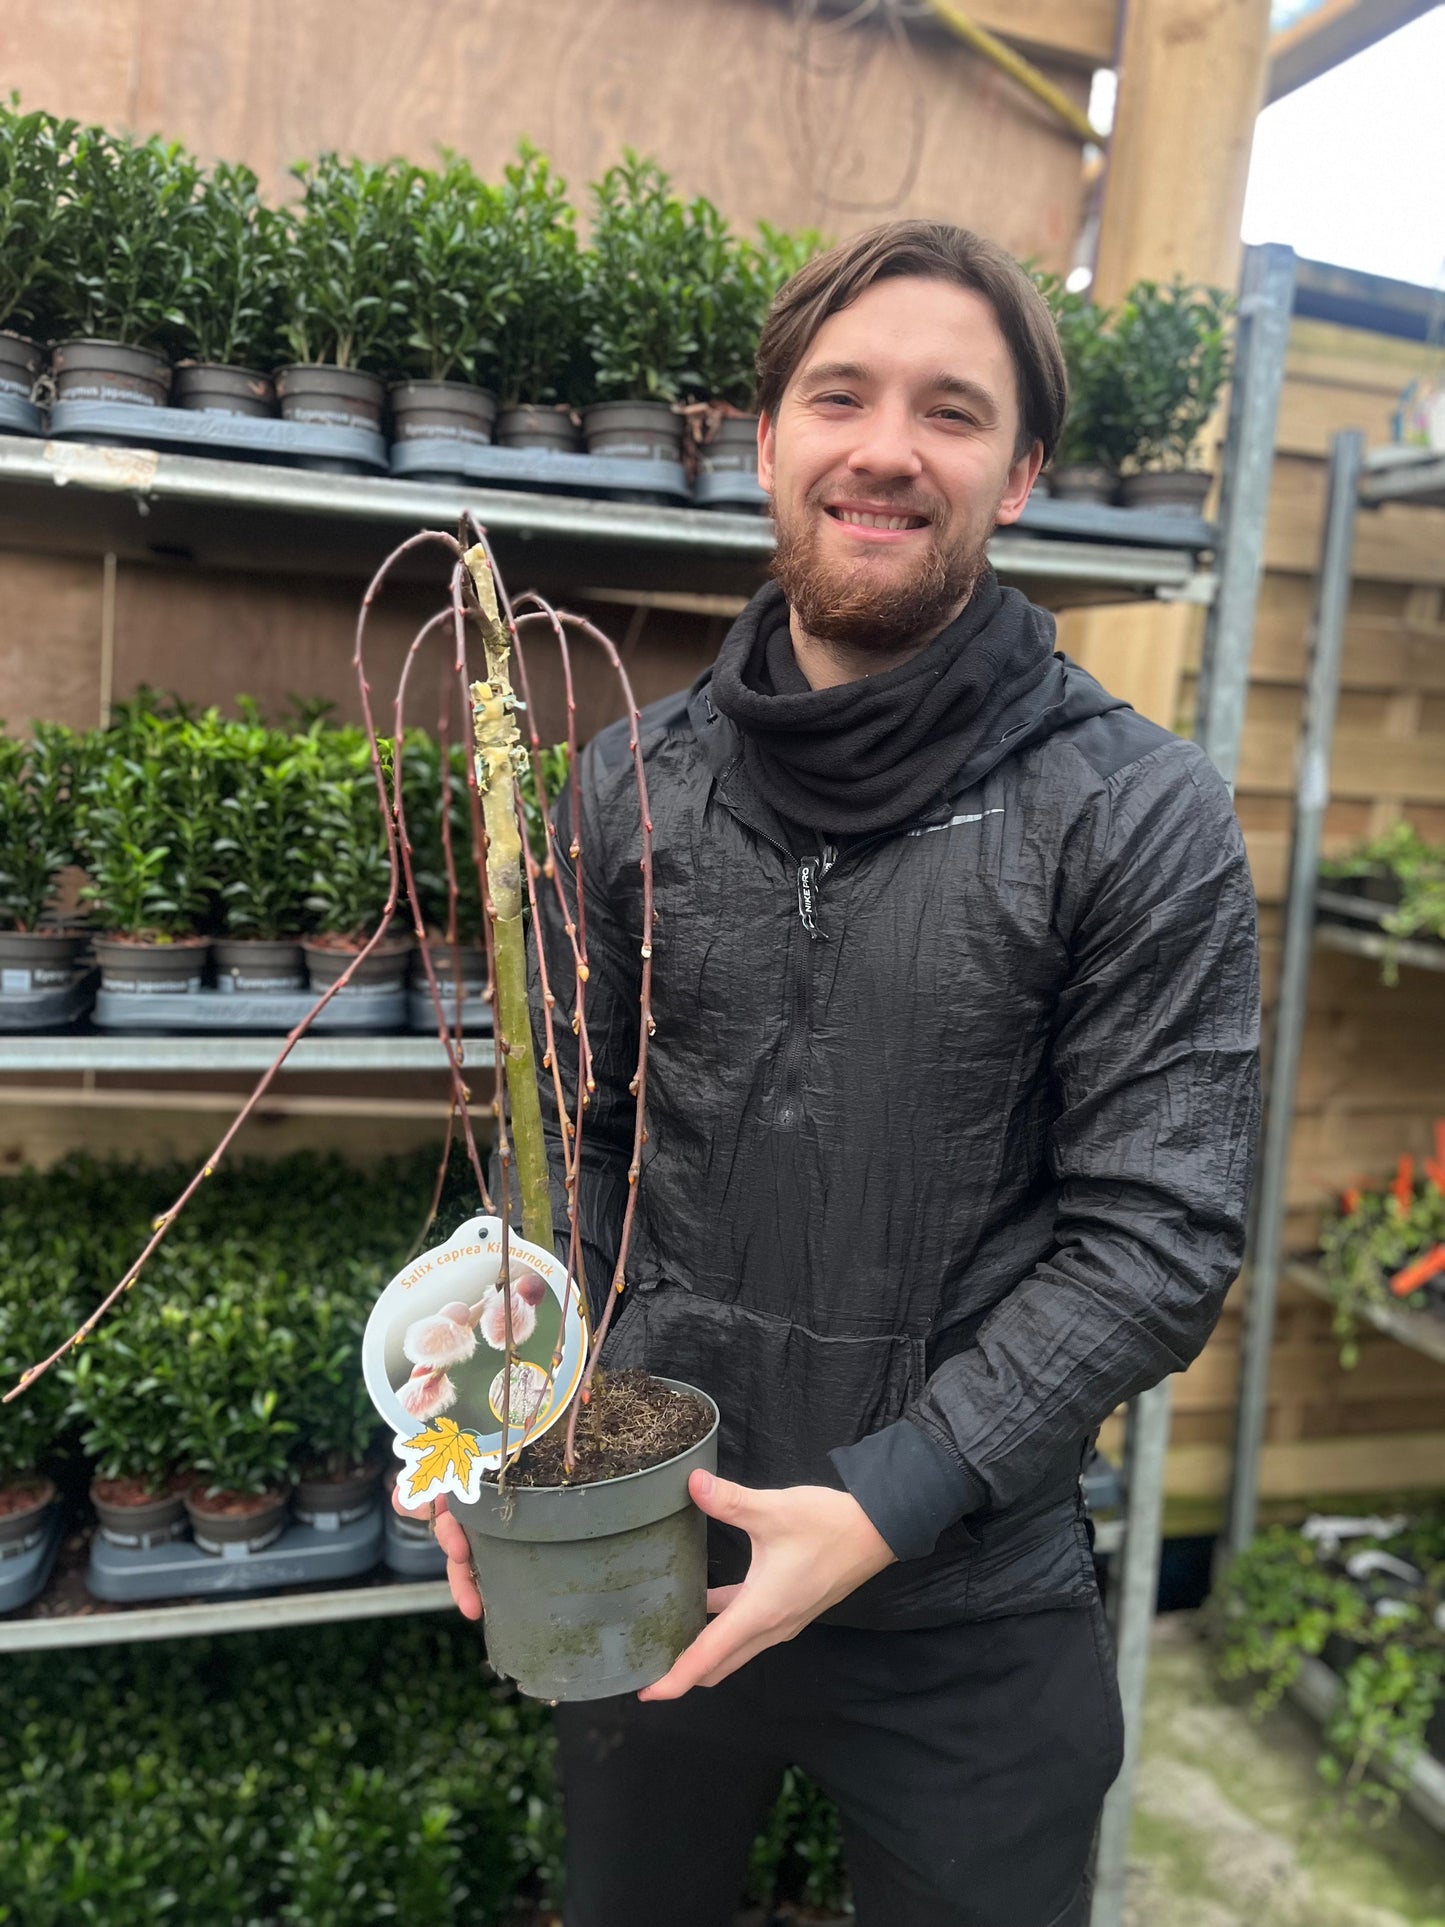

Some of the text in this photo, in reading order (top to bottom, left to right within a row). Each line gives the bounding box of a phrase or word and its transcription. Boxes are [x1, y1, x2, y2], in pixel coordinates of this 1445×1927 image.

[802, 867, 812, 912] NIKE PRO
[401, 1241, 554, 1289] Salix caprea Kimarnock
